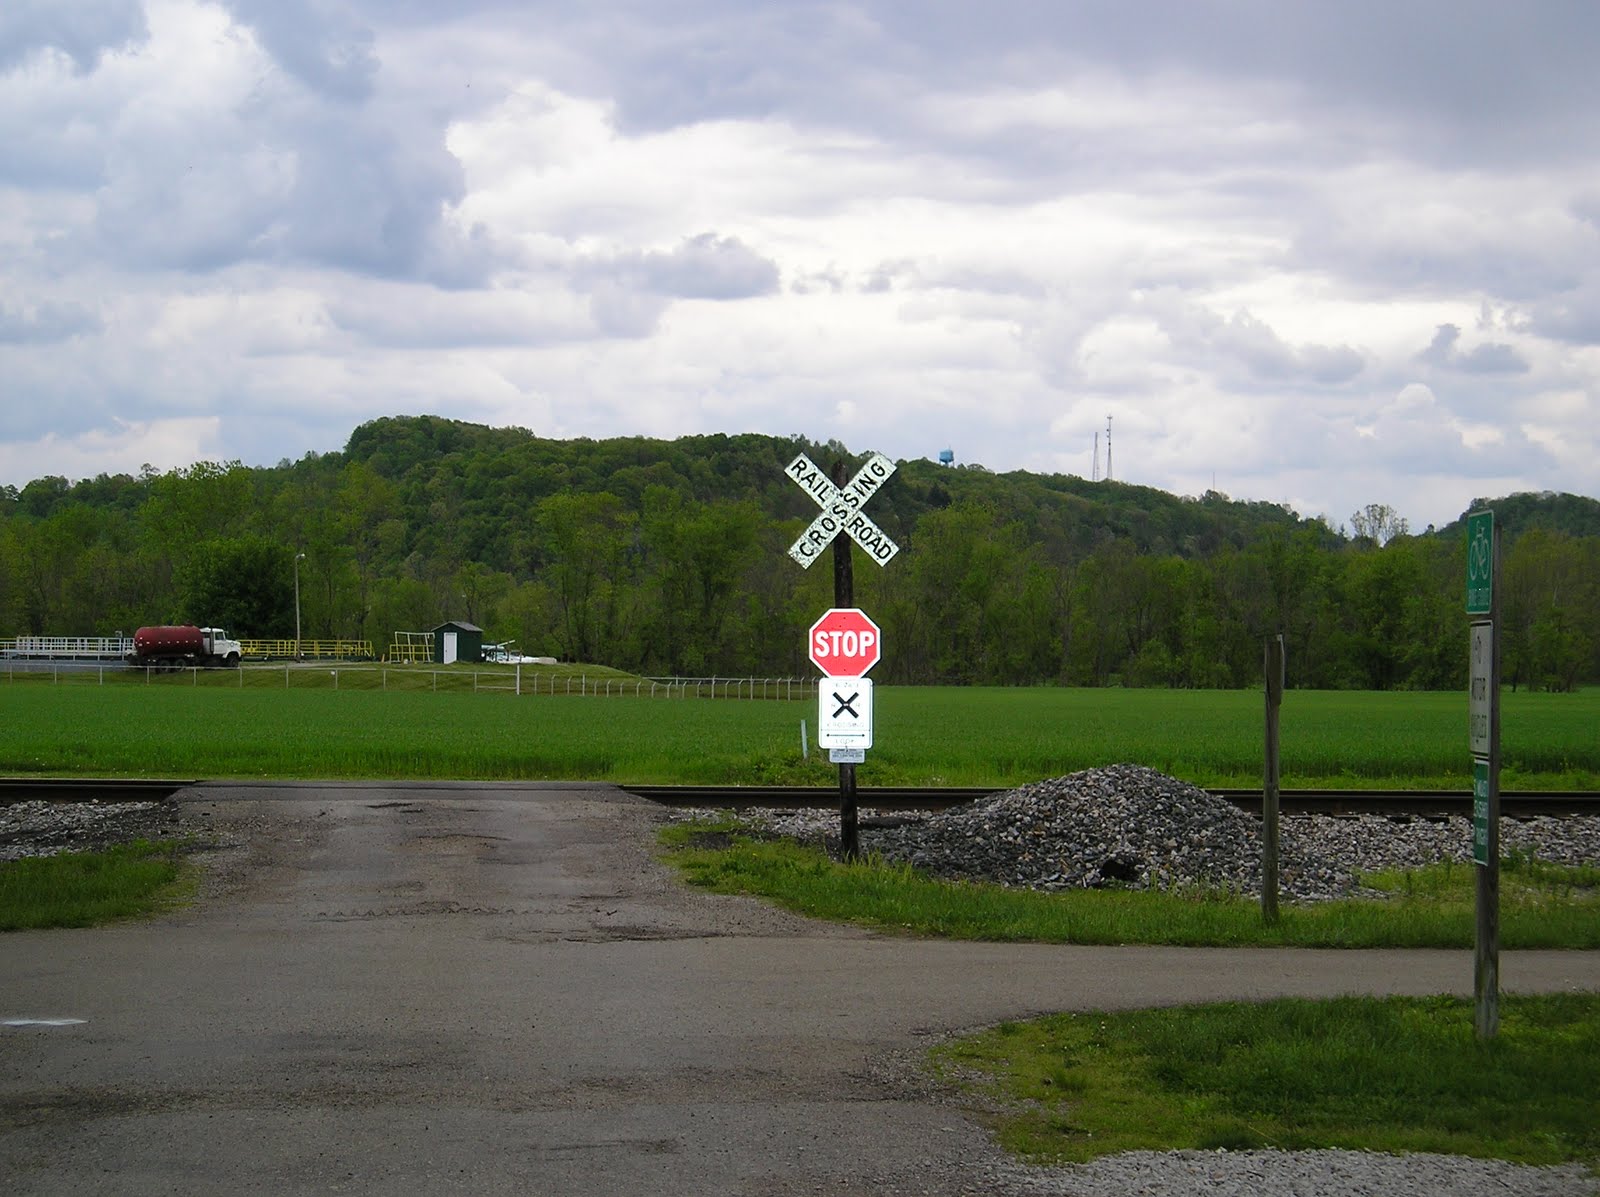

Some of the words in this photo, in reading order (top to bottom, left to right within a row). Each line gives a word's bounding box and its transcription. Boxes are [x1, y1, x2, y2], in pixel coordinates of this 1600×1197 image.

[791, 459, 829, 503] RAIL
[848, 516, 892, 559] ROAD
[799, 462, 886, 557] CROSSING
[814, 630, 875, 658] STOP
